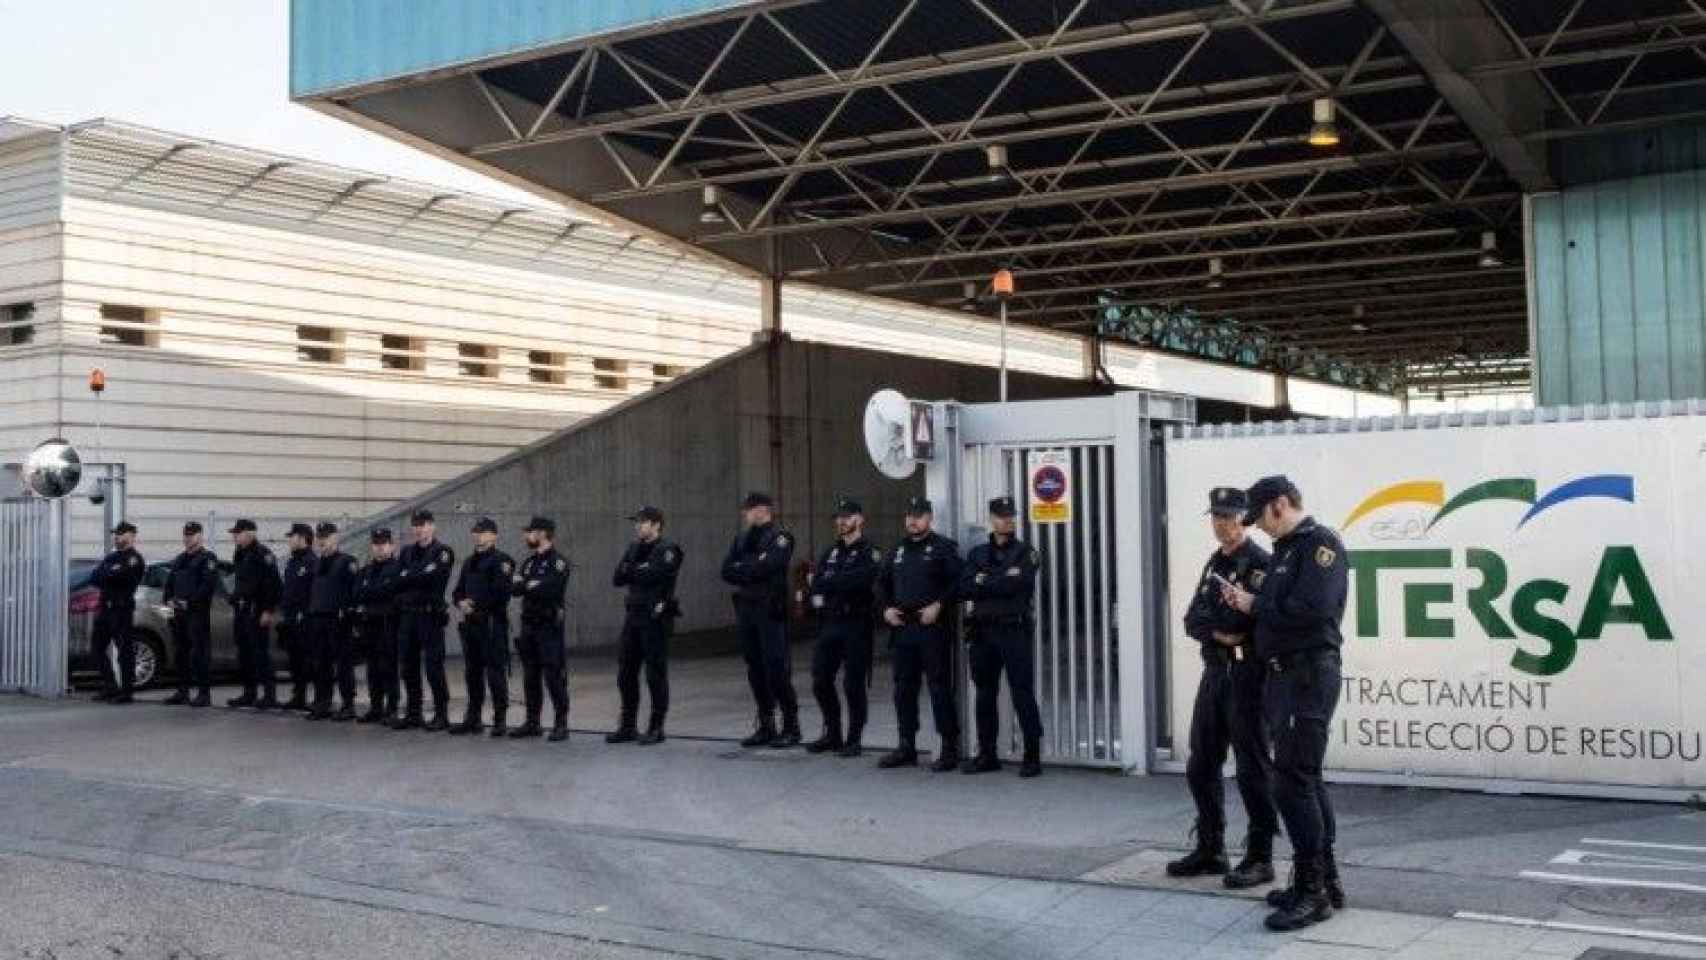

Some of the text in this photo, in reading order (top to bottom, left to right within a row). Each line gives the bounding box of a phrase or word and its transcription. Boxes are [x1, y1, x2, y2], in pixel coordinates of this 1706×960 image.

[1345, 545, 1674, 676] TERSA
[1341, 676, 1552, 710] TRACTAMENT
[1342, 718, 1348, 746] I
[1358, 715, 1514, 752] SELECCIÓ
[1526, 725, 1568, 756] DE
